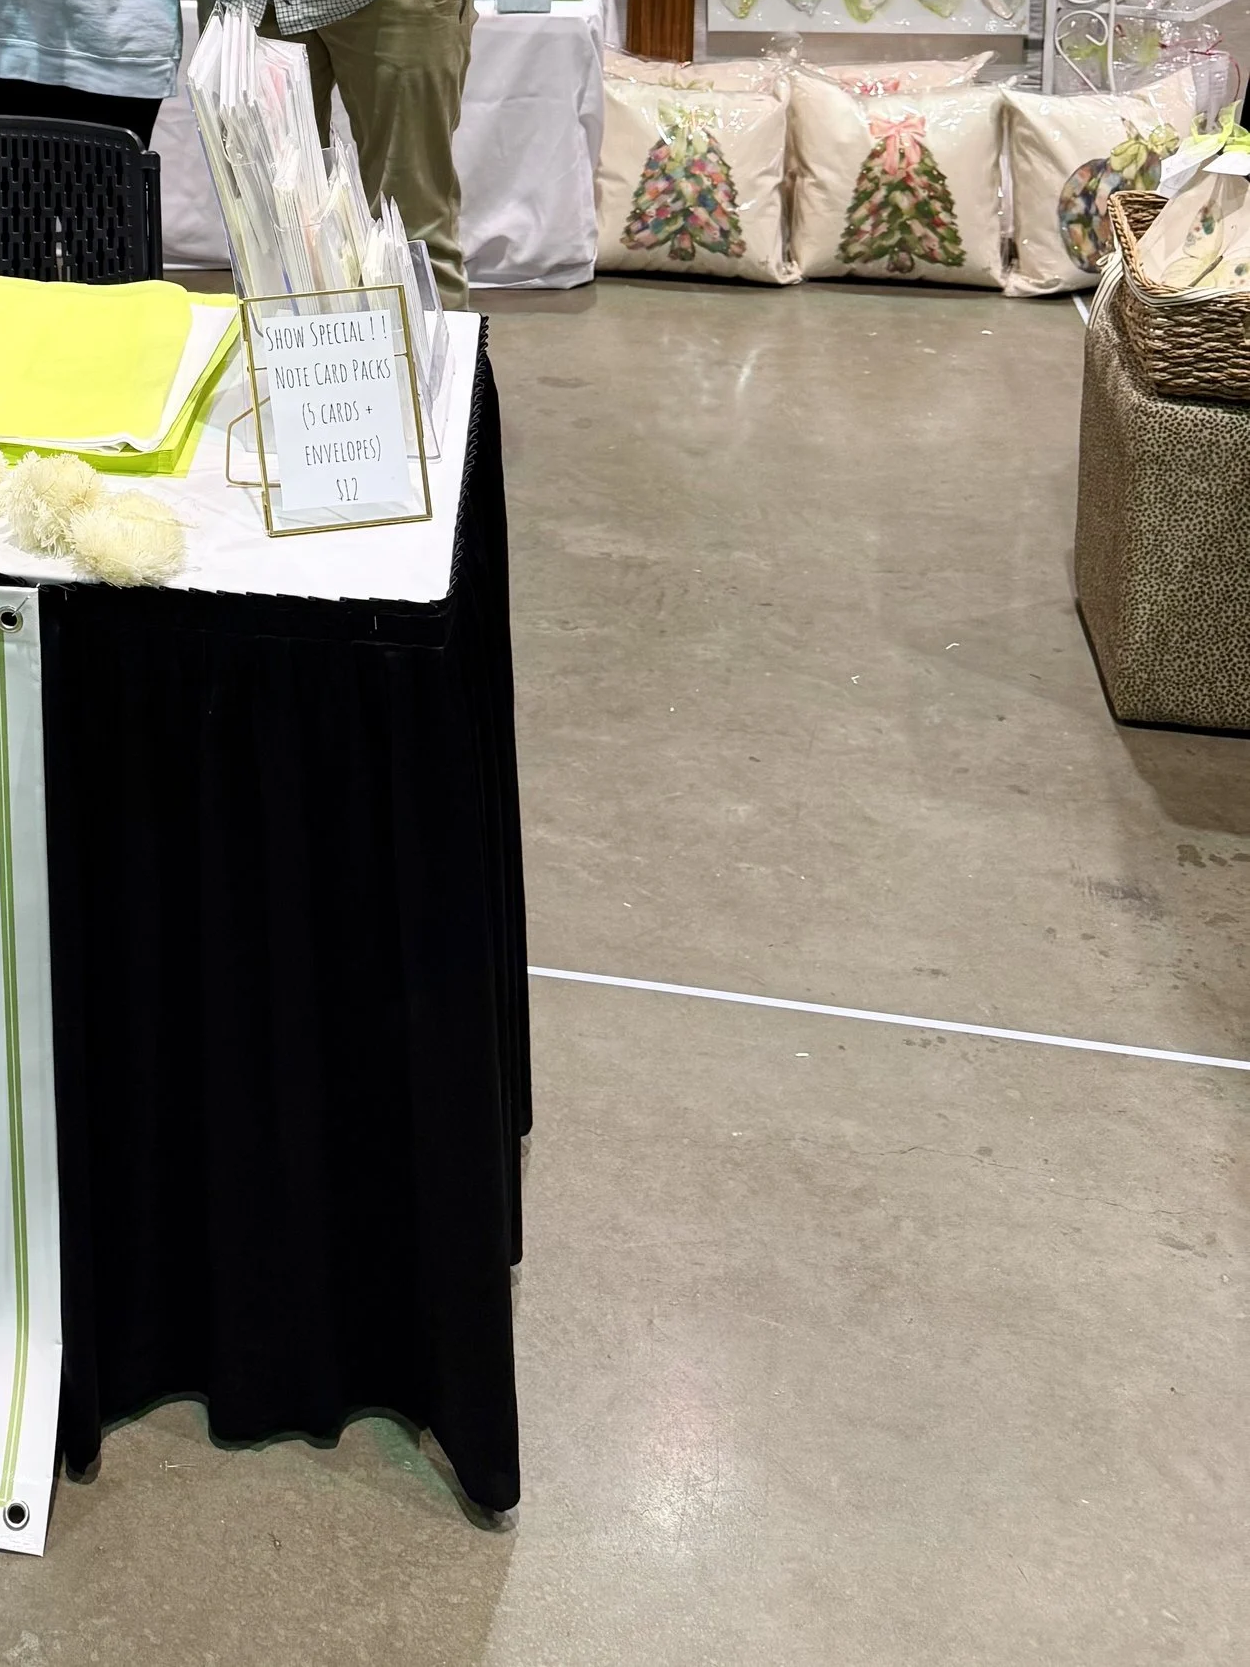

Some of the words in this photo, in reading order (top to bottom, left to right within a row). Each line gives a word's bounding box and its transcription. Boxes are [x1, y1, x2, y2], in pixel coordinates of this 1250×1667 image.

[265, 325, 305, 352] SHOW
[309, 319, 366, 347] SPECIAL
[275, 365, 310, 390] NOTE
[313, 361, 348, 387] CARD
[352, 357, 391, 382] PACKS
[302, 402, 316, 430] (5
[320, 400, 360, 425] CARDS
[365, 404, 373, 415] +
[305, 434, 382, 466] ENVELOPES)
[336, 477, 359, 502] $12
